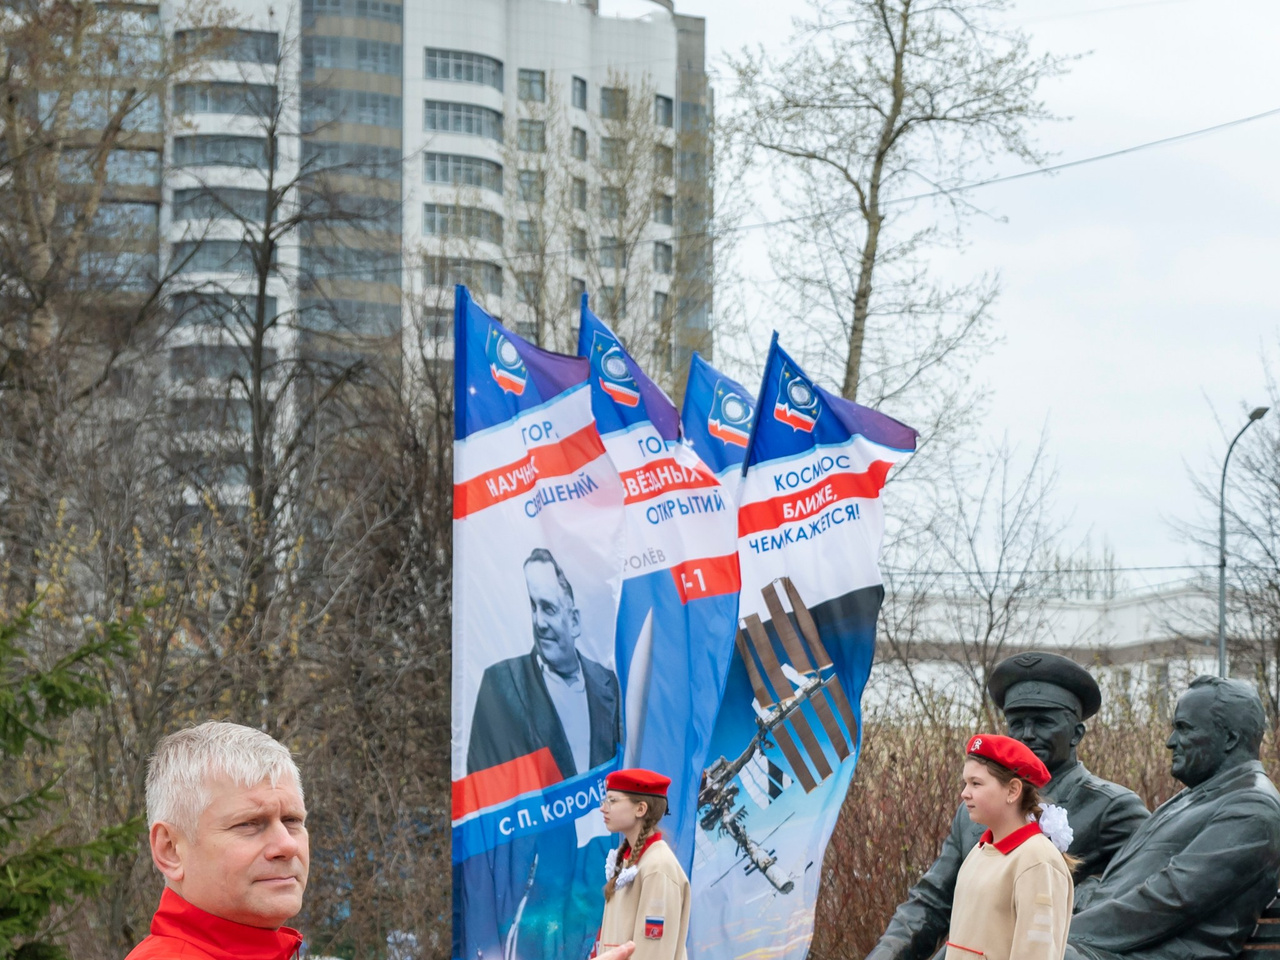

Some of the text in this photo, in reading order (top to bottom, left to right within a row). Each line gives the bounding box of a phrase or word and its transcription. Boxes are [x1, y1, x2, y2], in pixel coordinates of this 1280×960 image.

[774, 455, 850, 491] КОСМОС
[646, 489, 726, 525] ОТКРЫТИЙ
[783, 484, 838, 520] БЛИЖЕ,
[517, 808, 538, 829] П.
[541, 778, 607, 823] КОРОЛЁ
